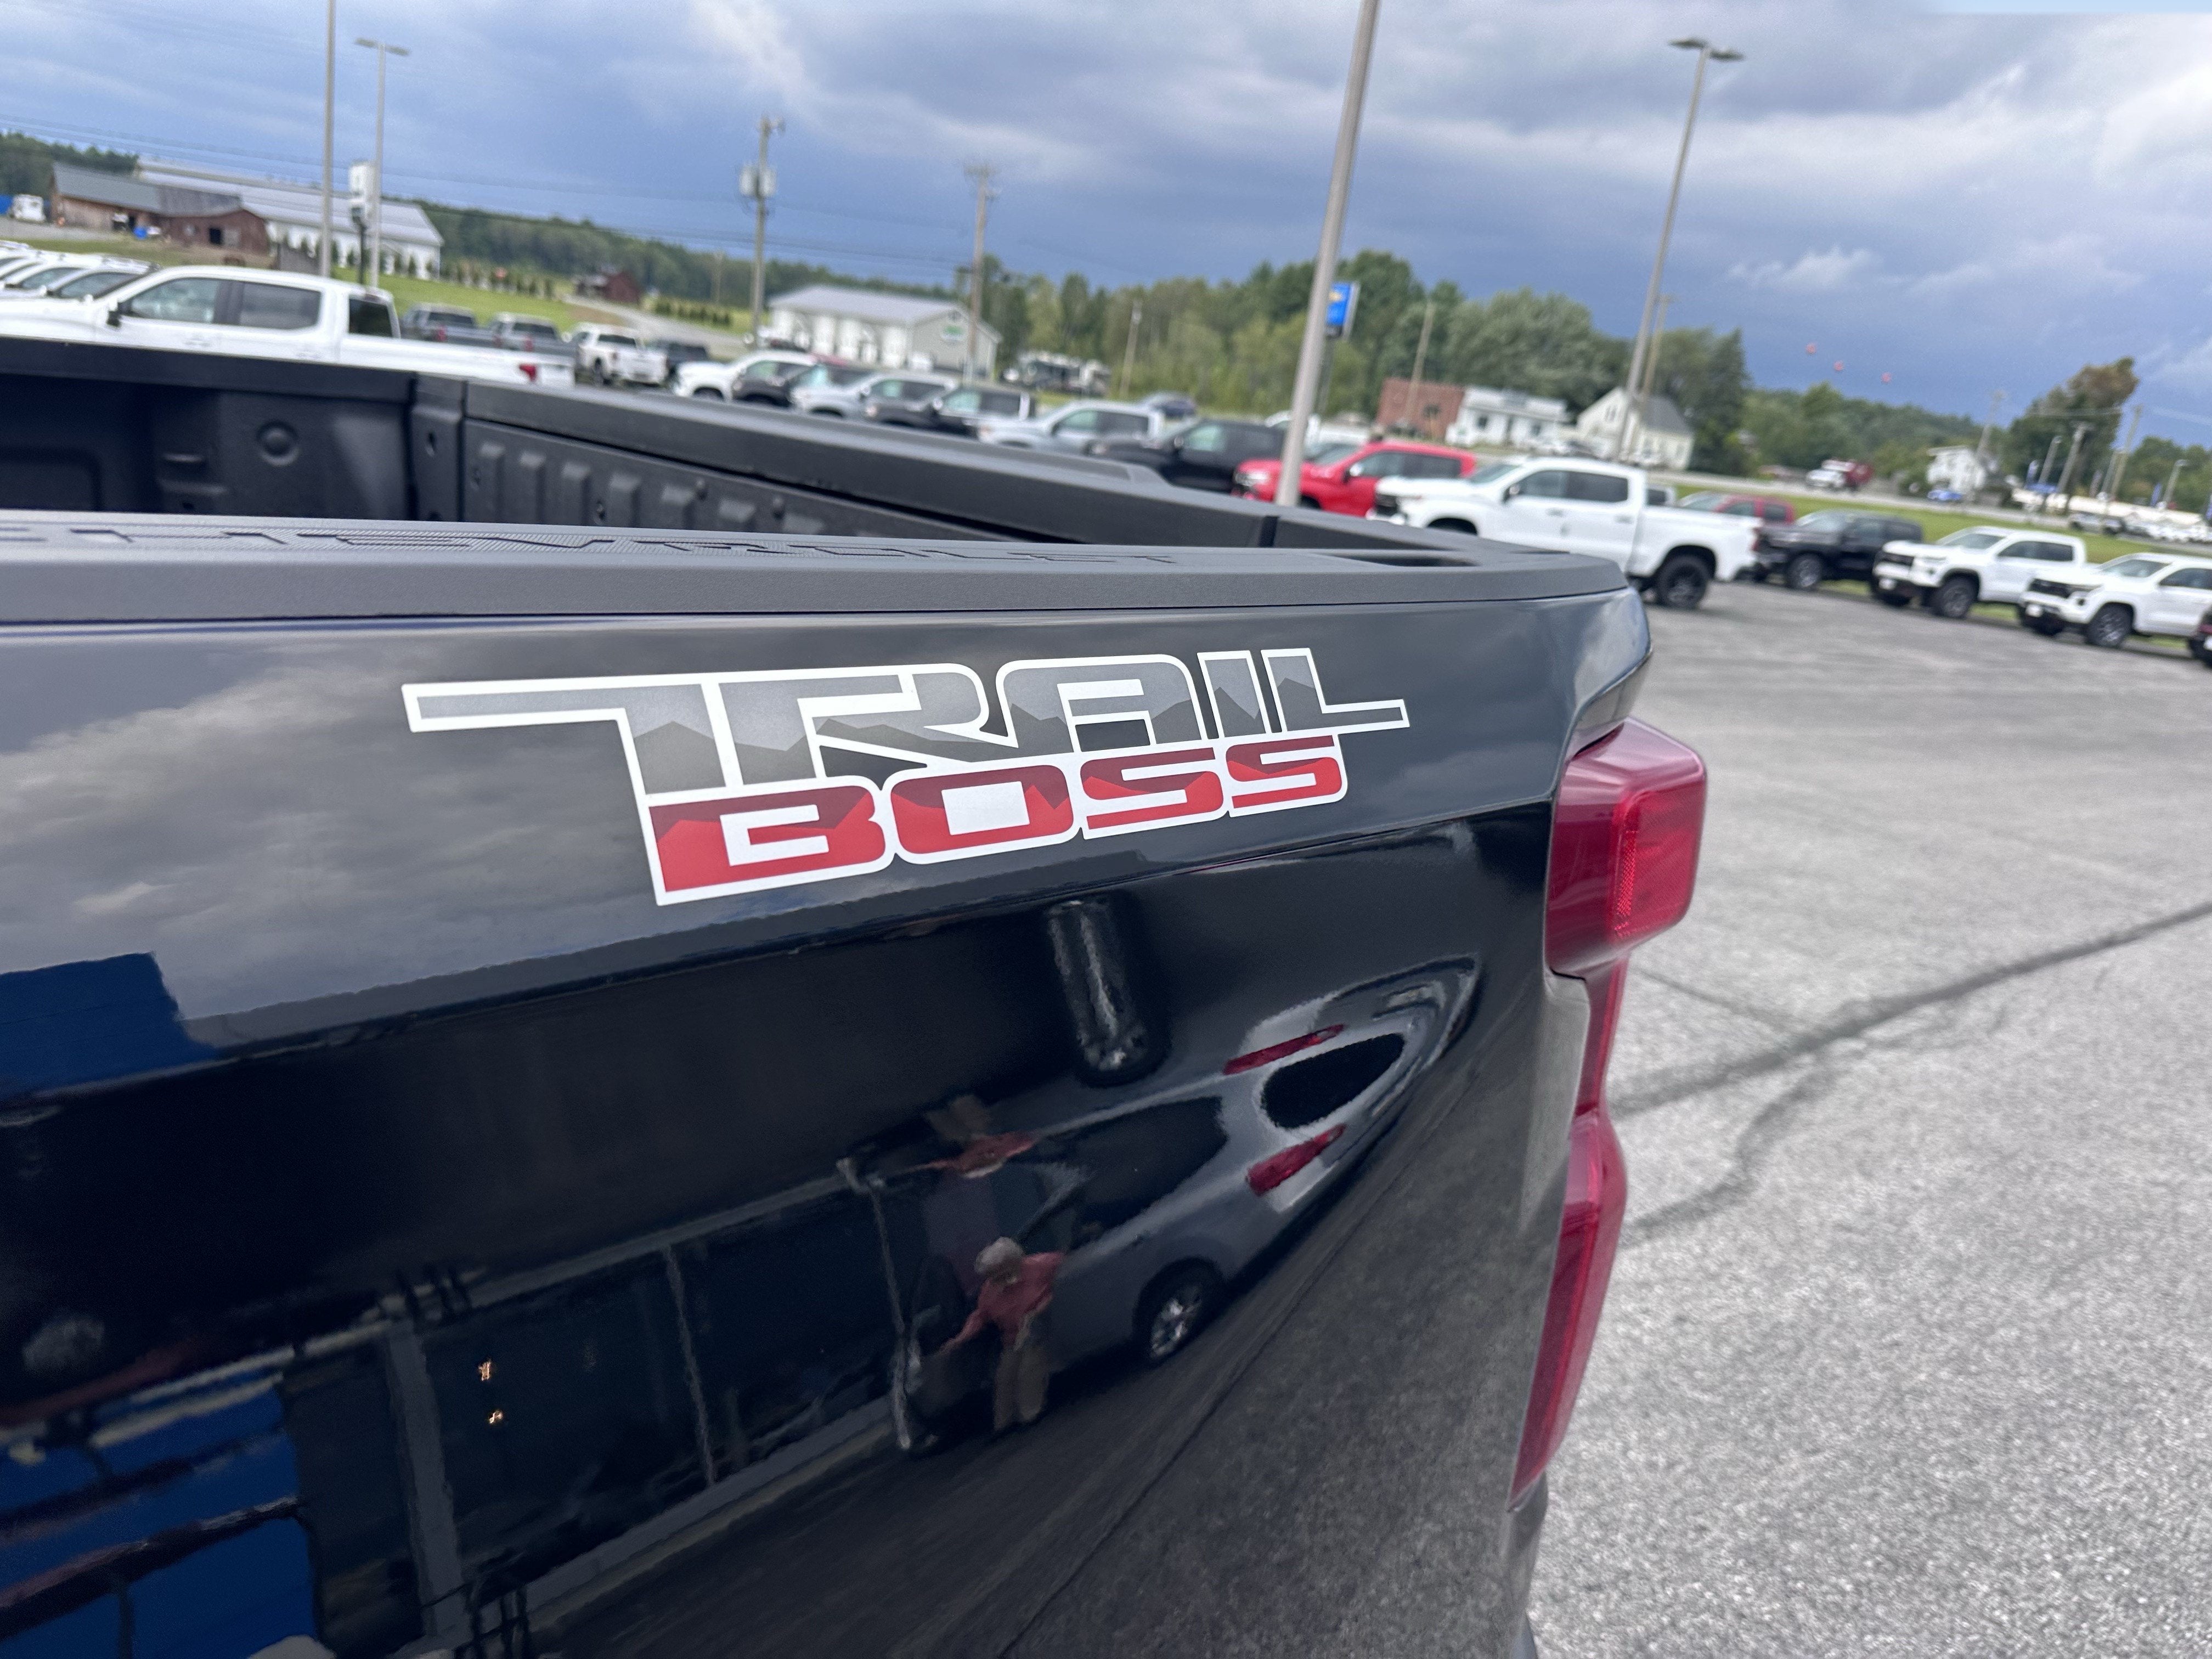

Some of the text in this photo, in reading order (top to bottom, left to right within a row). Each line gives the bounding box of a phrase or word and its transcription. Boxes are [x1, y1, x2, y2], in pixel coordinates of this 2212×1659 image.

[0, 526, 1177, 564] HEVROLET
[402, 648, 1410, 797] TRAIL
[643, 733, 1350, 906] BOSS
